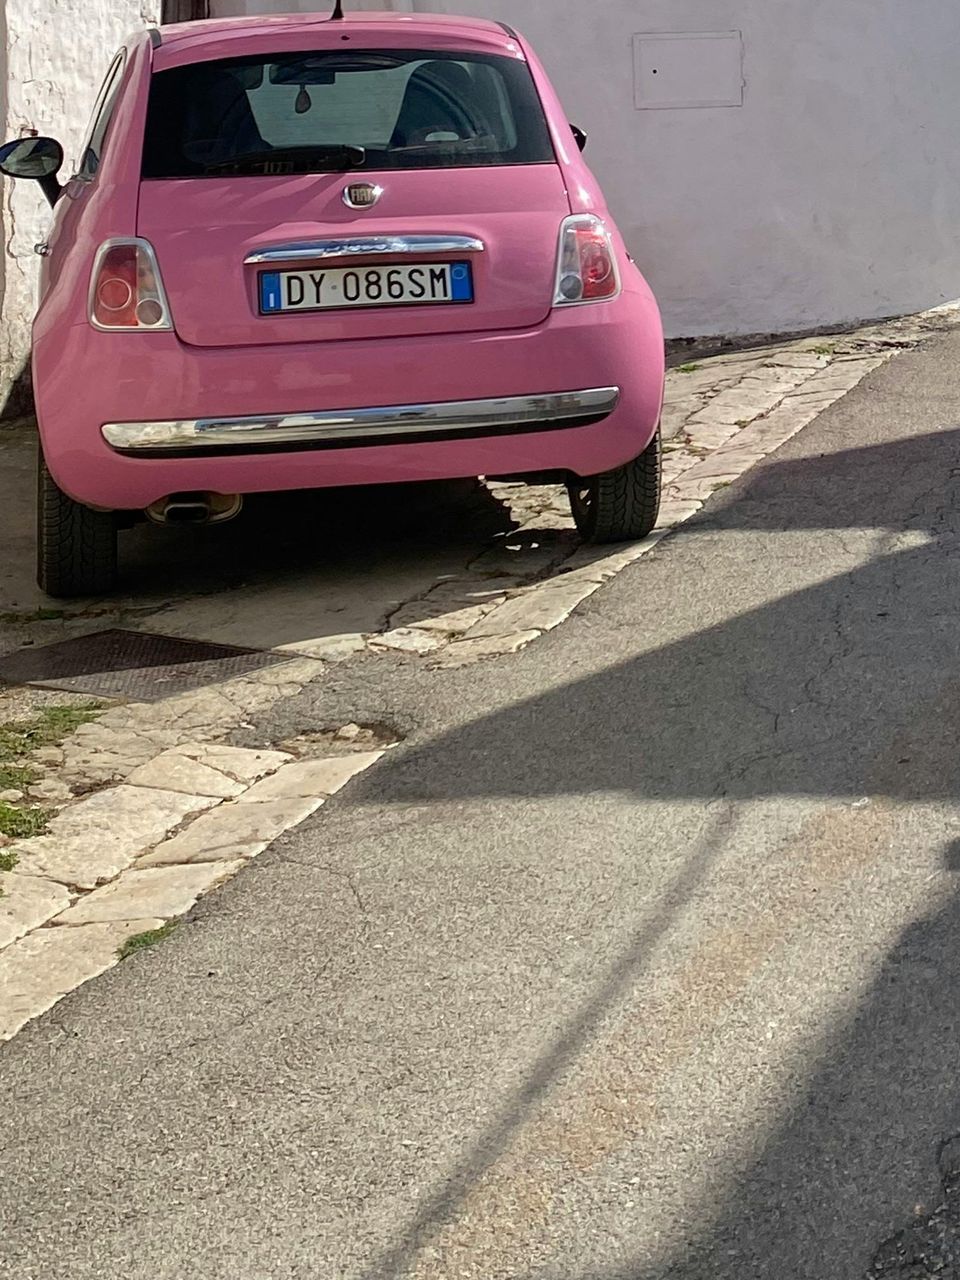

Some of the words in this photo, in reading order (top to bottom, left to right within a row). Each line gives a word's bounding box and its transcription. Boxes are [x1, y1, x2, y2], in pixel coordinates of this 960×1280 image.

[351, 187, 375, 202] FIAT
[286, 273, 326, 306] DY
[343, 267, 448, 302] 086SM
